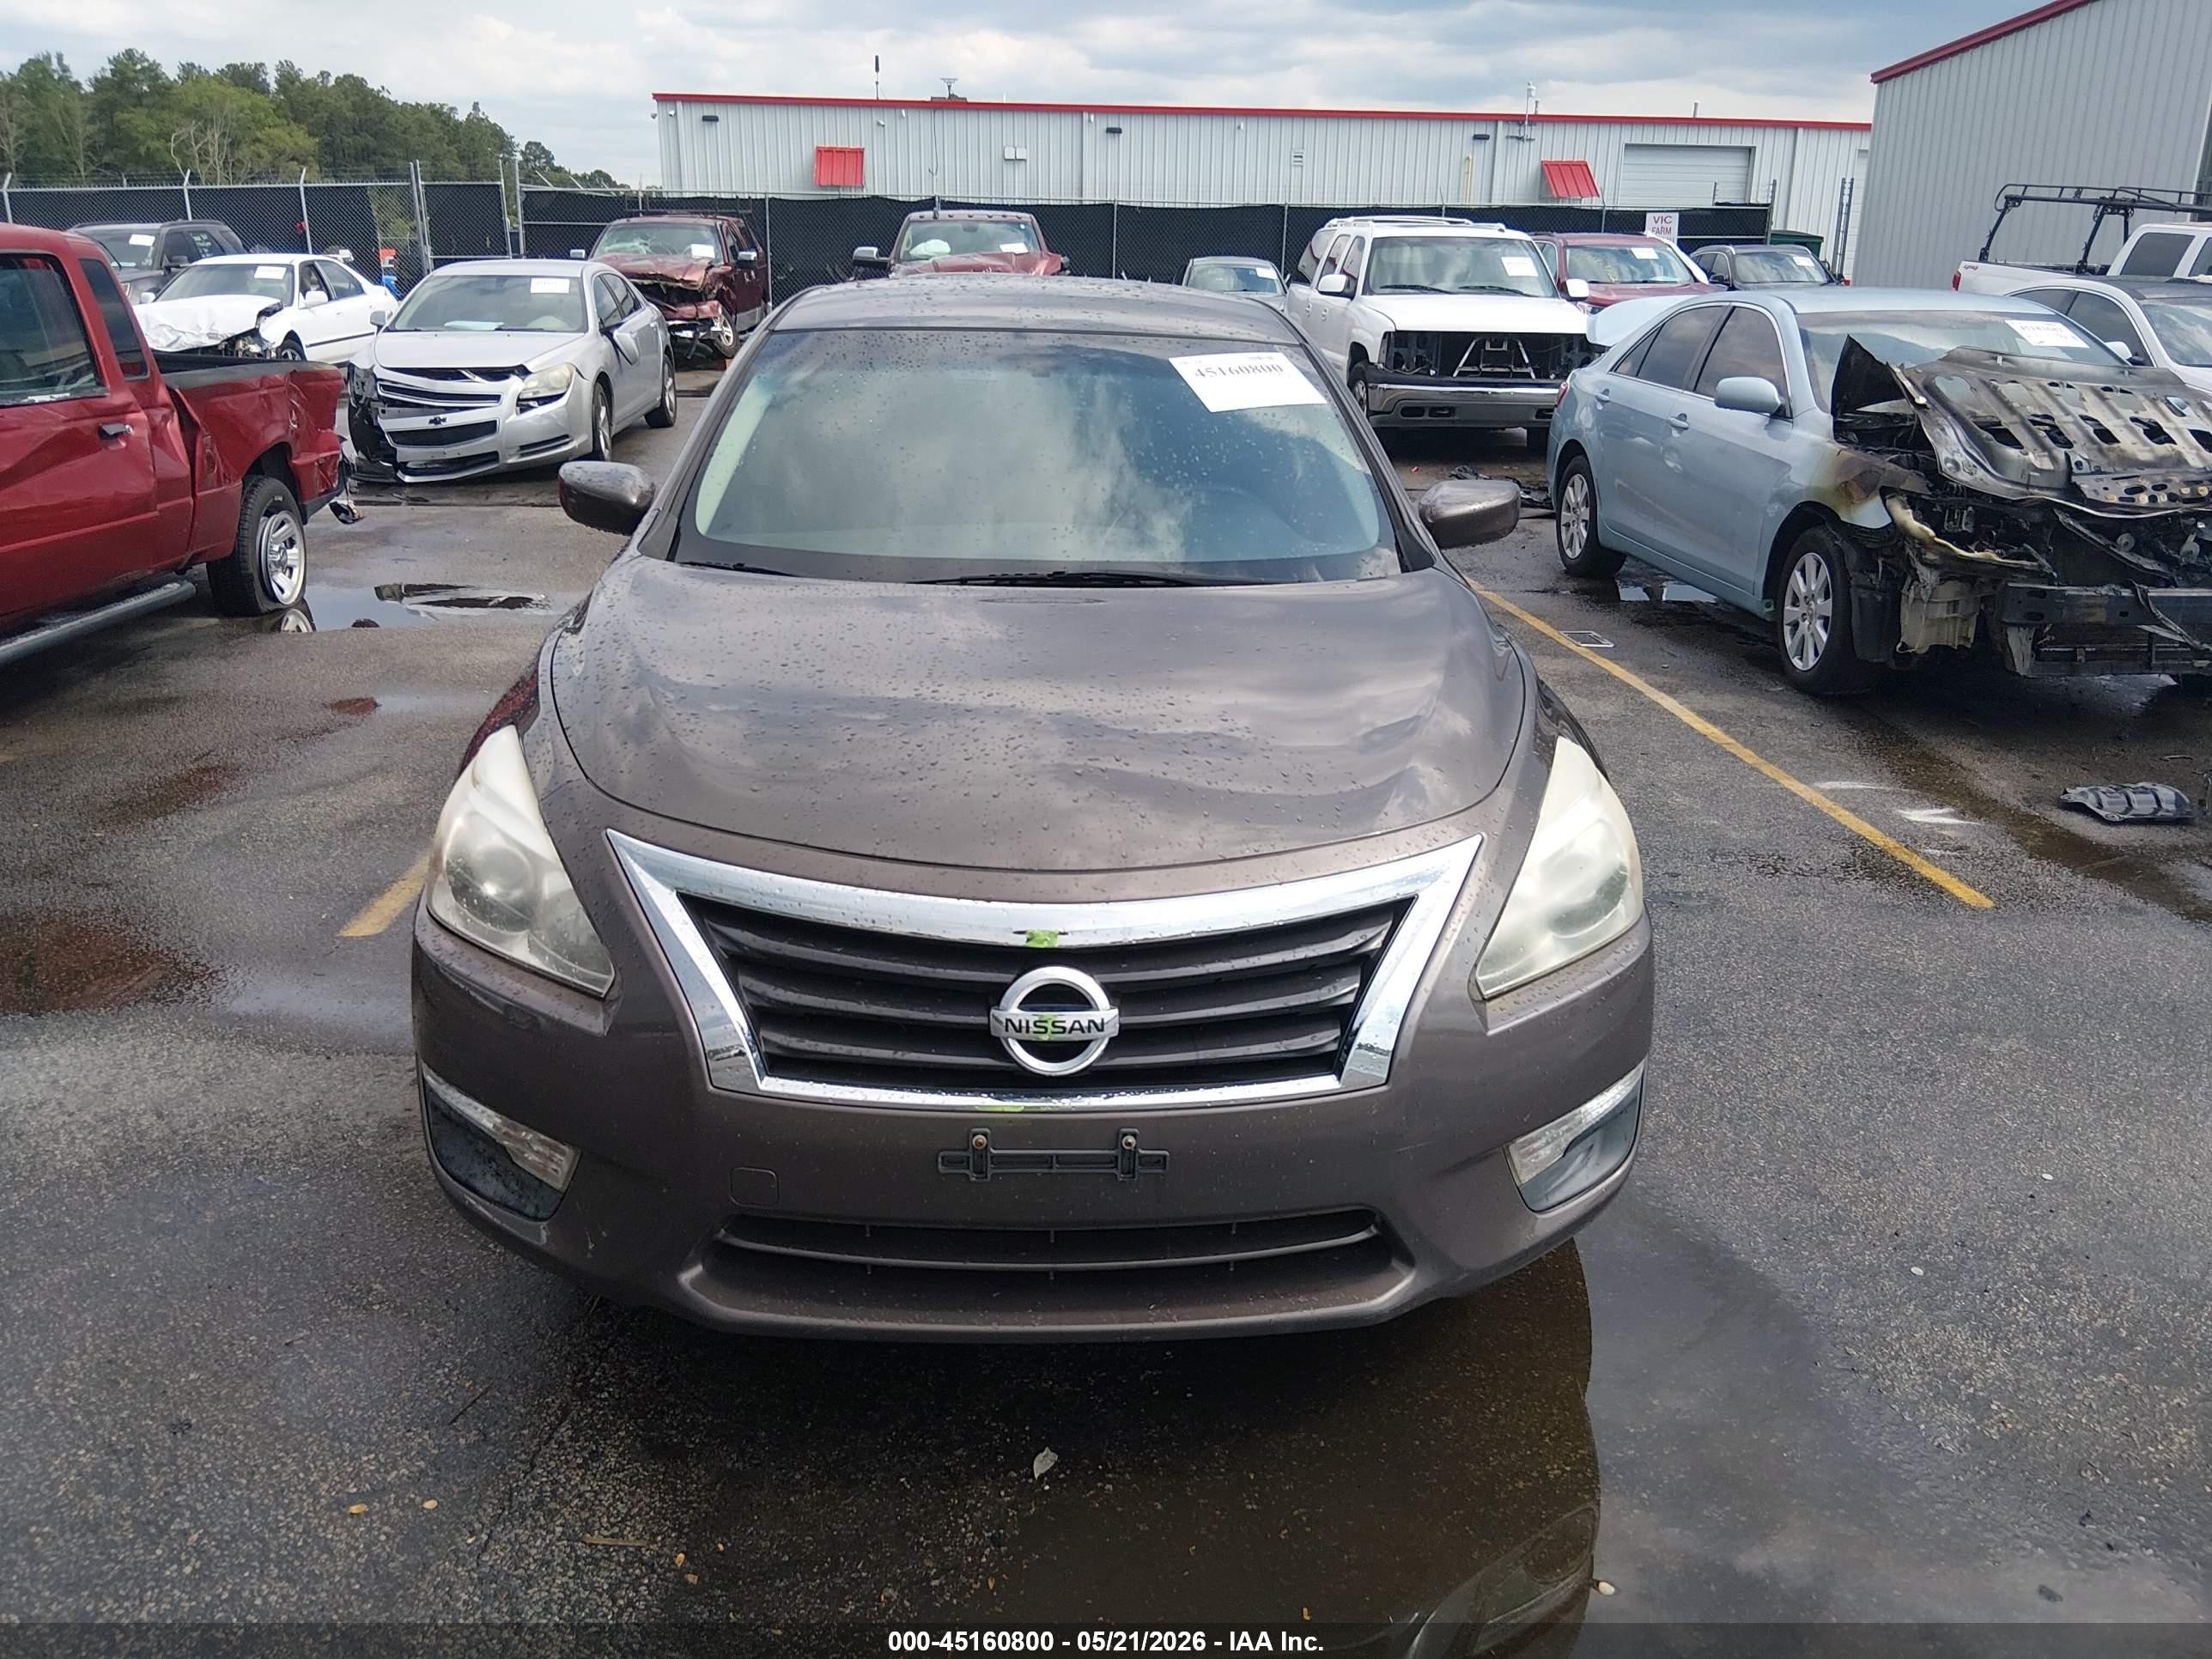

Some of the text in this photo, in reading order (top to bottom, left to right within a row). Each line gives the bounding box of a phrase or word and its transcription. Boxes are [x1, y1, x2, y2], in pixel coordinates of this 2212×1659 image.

[1653, 216, 1673, 224] VIC
[1651, 226, 1672, 235] FARM
[1194, 363, 1285, 378] 45160800
[1005, 1018, 1105, 1035] NISSAN
